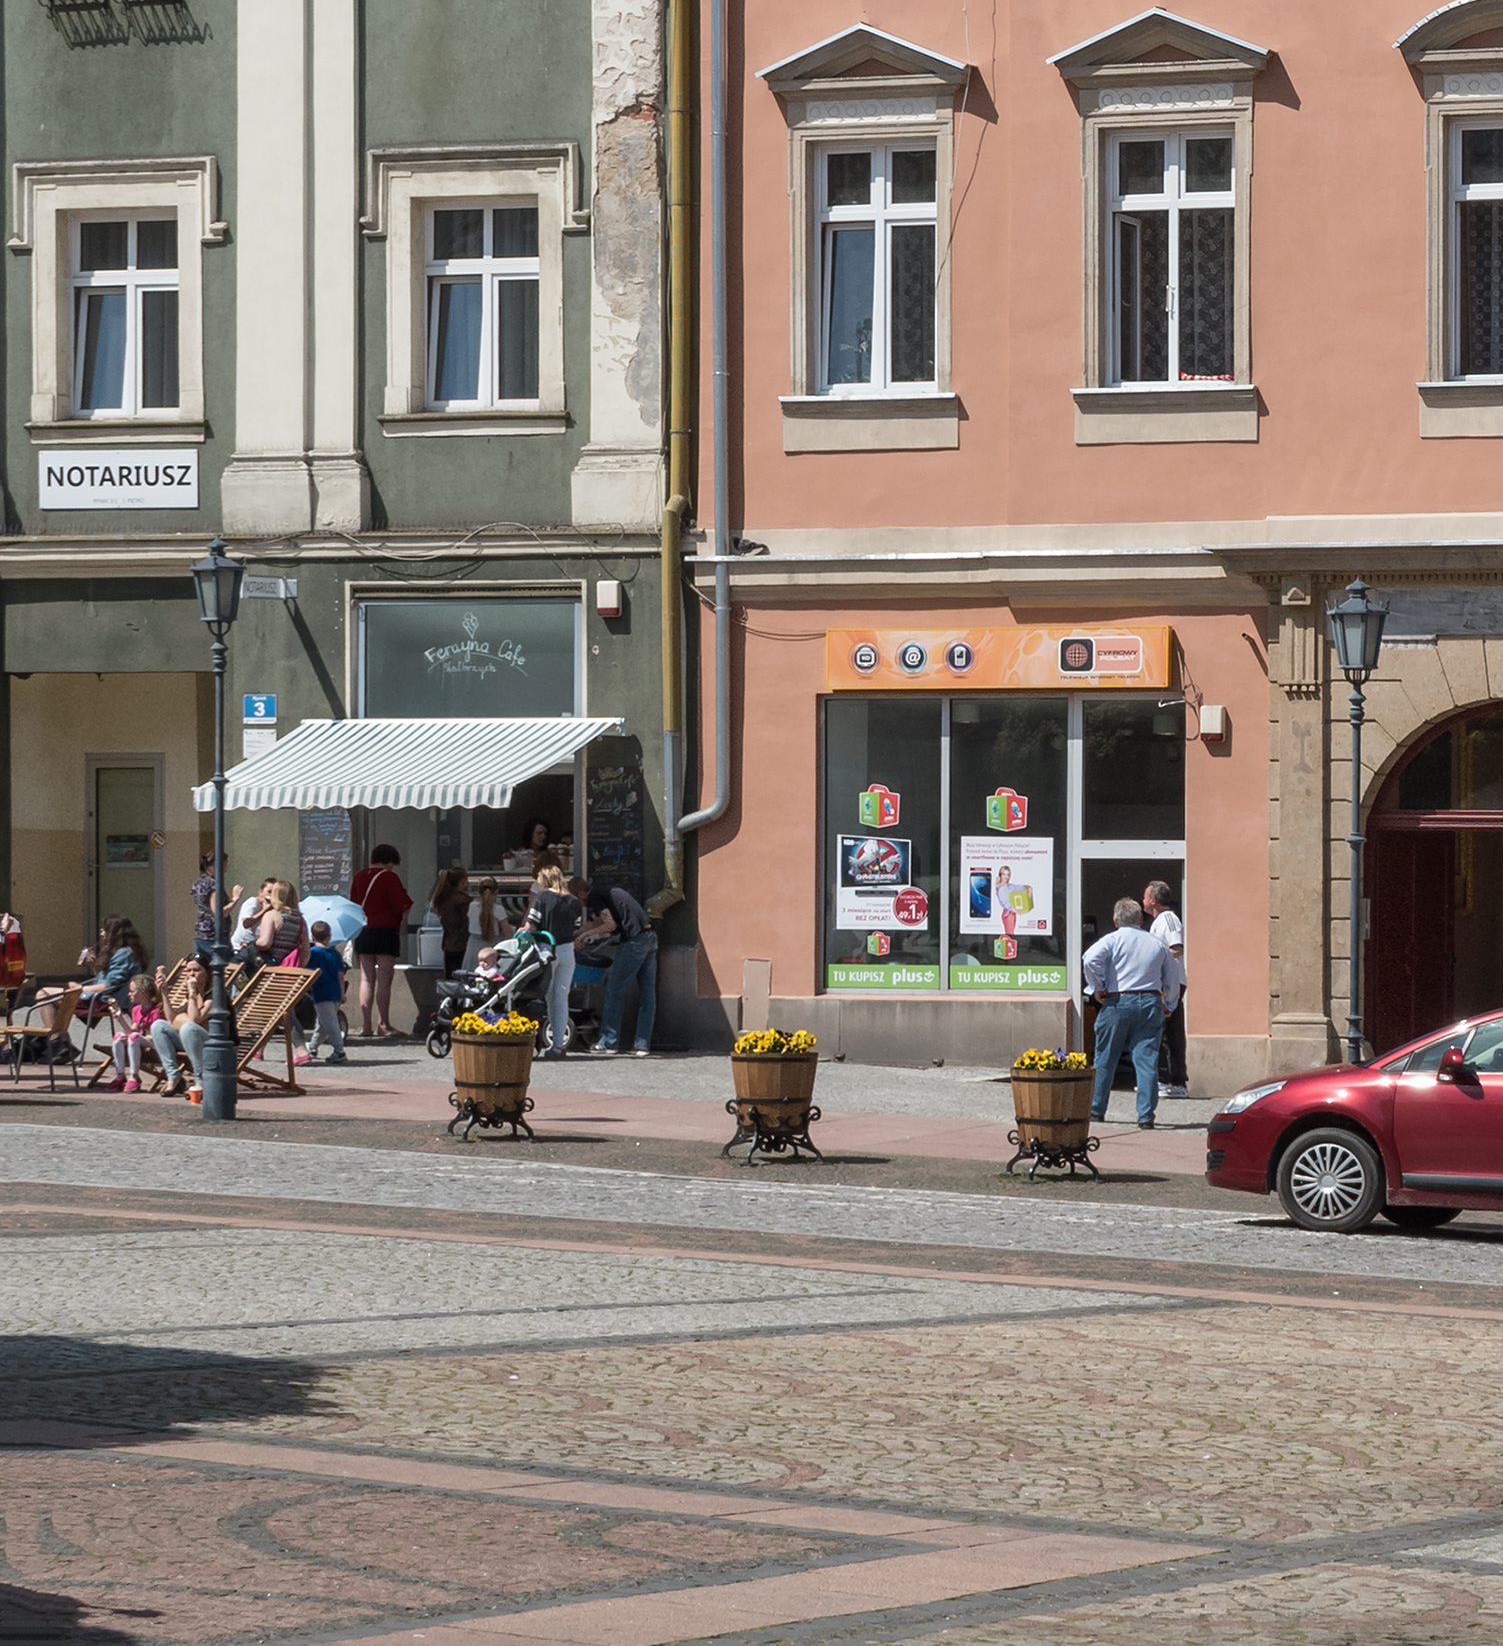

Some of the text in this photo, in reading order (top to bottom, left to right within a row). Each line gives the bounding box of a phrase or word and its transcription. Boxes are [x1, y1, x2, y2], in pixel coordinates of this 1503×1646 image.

[47, 465, 192, 487] NOTARIUSZ
[254, 702, 266, 717] 3
[833, 968, 923, 986] TU KUPISZ plus
[957, 969, 1049, 987] TU KUPISZ plus
